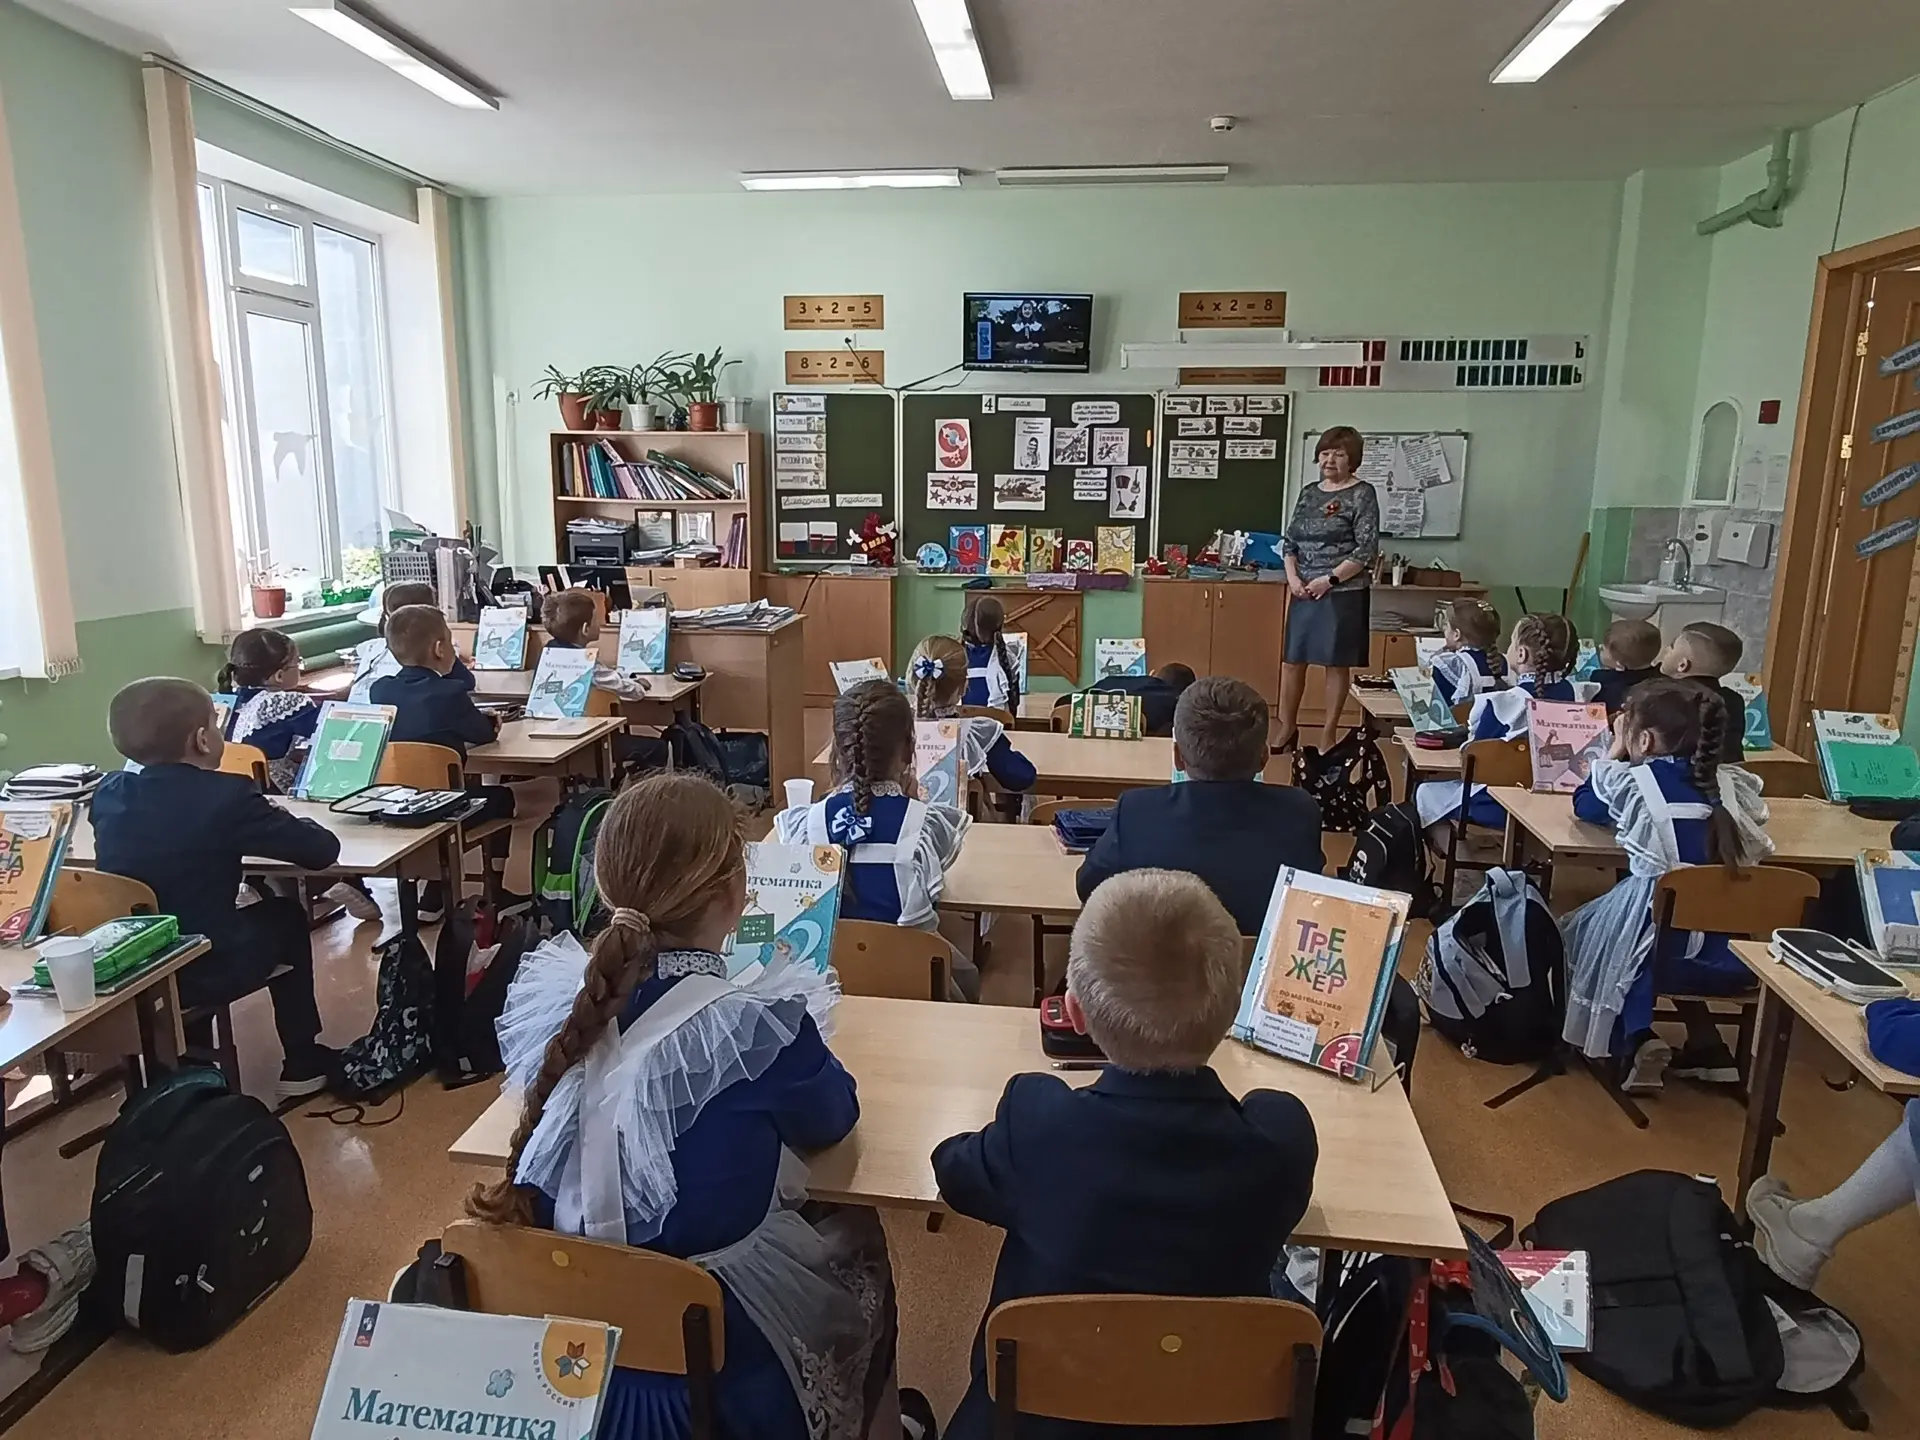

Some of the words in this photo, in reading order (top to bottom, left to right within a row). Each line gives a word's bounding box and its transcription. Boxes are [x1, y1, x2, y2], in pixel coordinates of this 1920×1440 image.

[799, 302, 807, 314] 3
[831, 302, 839, 314] 2
[863, 302, 871, 314] 5
[1195, 300, 1204, 312] 4
[1230, 299, 1238, 312] 2
[1264, 299, 1273, 311] 8
[800, 357, 809, 369] 8
[830, 357, 838, 369] 2
[862, 357, 870, 369] 6
[984, 398, 994, 412] 4
[1032, 535, 1045, 553] 9
[563, 682, 585, 709] 2
[1432, 699, 1453, 726] 2
[1536, 718, 1598, 730] Математика
[1745, 708, 1766, 736] 2
[1826, 728, 1892, 741] Математика
[747, 875, 823, 890] тематика
[10, 917, 21, 930] 2
[1335, 1042, 1350, 1059] 2
[541, 1382, 576, 1409] РОССИИ
[341, 1386, 558, 1440] Математика
